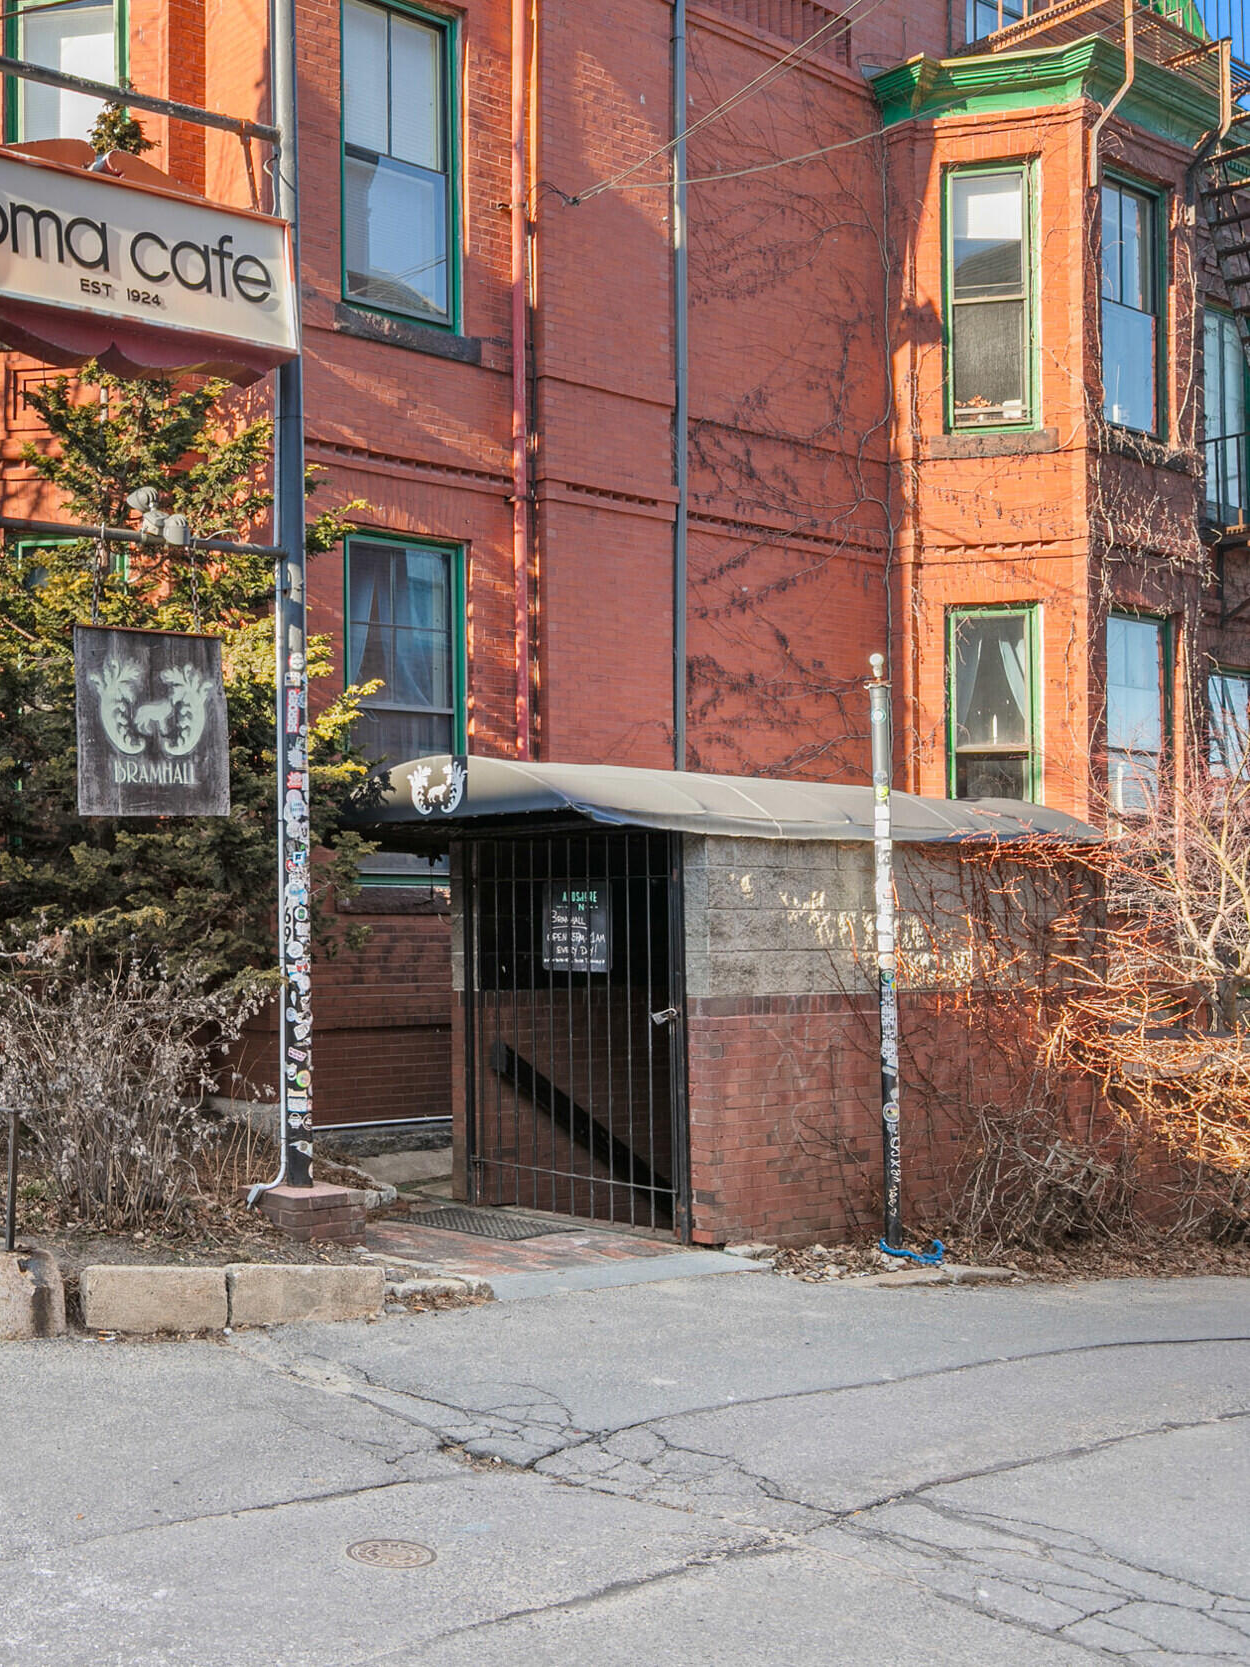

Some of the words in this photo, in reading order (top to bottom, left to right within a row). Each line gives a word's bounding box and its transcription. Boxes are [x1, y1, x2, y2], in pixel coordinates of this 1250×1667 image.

[129, 231, 272, 304] cafe
[80, 278, 112, 297] EST
[126, 288, 162, 306] 1924
[114, 760, 198, 785] BRAMHALL
